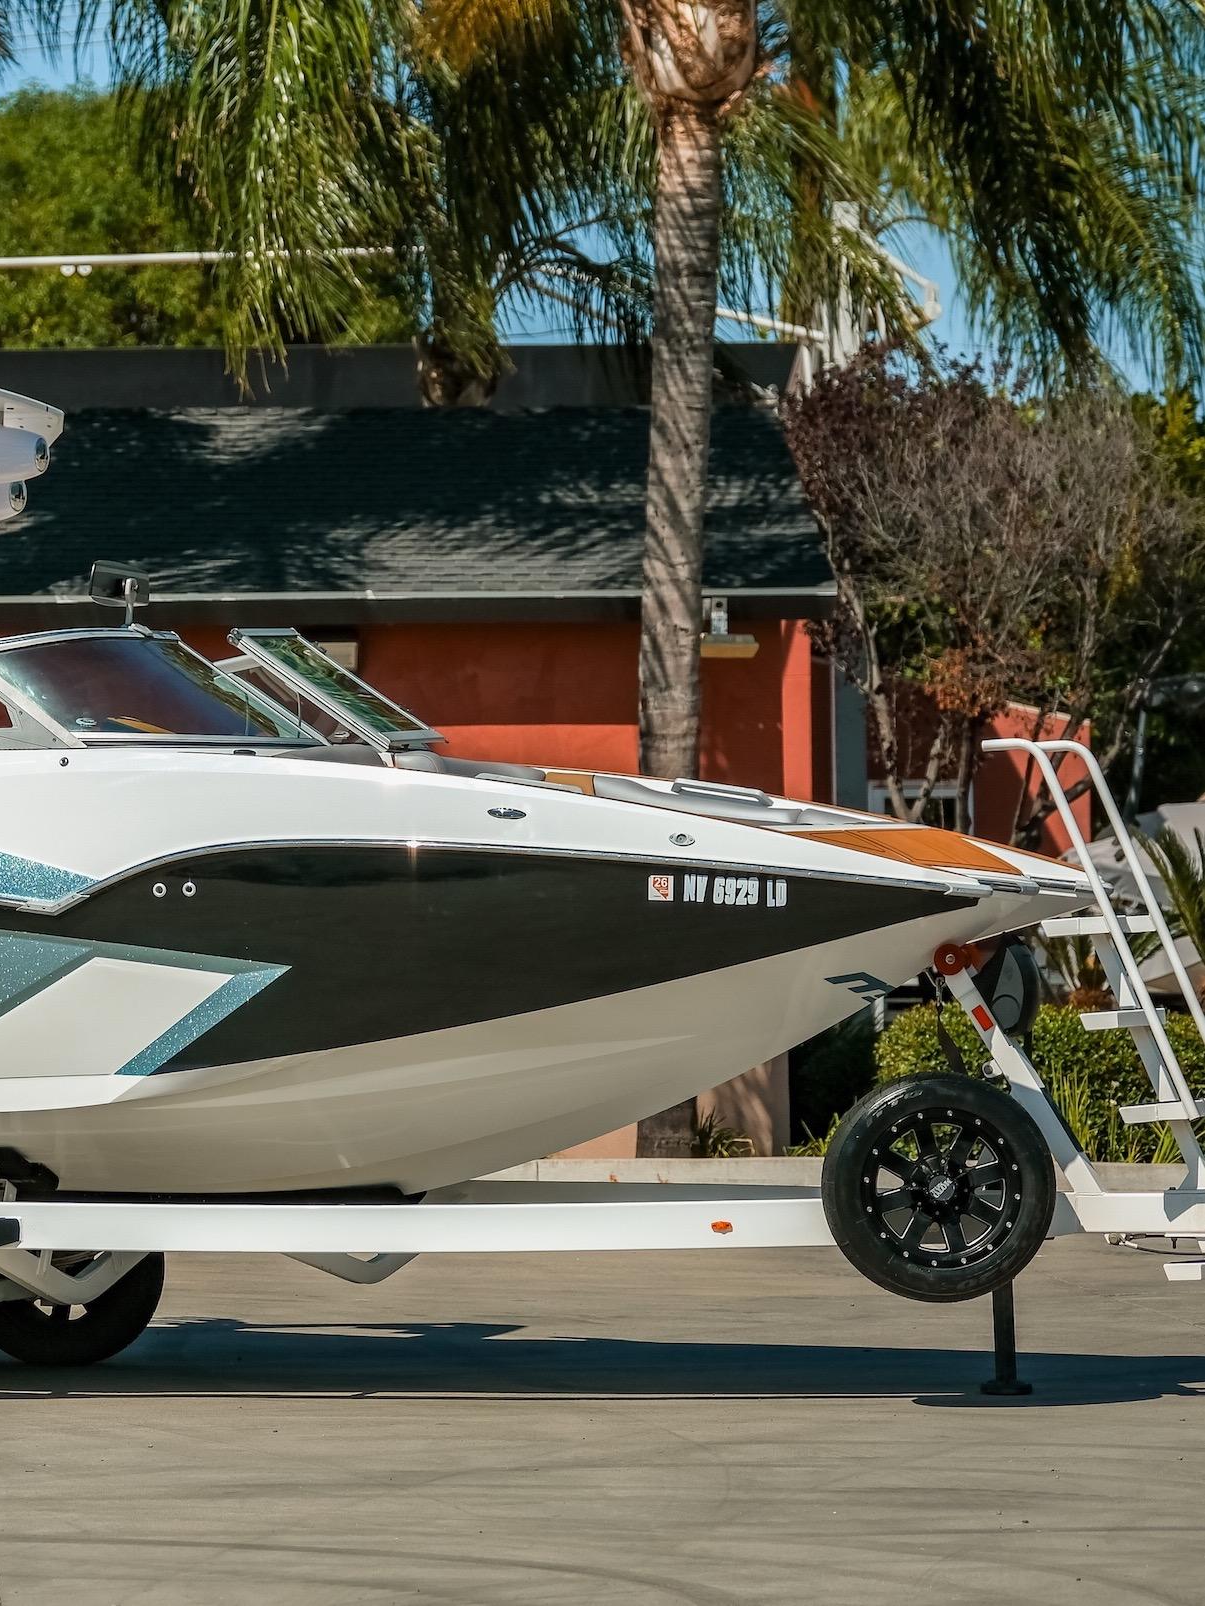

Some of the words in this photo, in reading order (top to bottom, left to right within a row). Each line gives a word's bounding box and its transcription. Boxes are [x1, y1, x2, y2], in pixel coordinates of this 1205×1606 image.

[654, 877, 668, 888] 26
[683, 874, 708, 903] NV
[712, 876, 760, 906] 6929
[766, 879, 788, 908] LD
